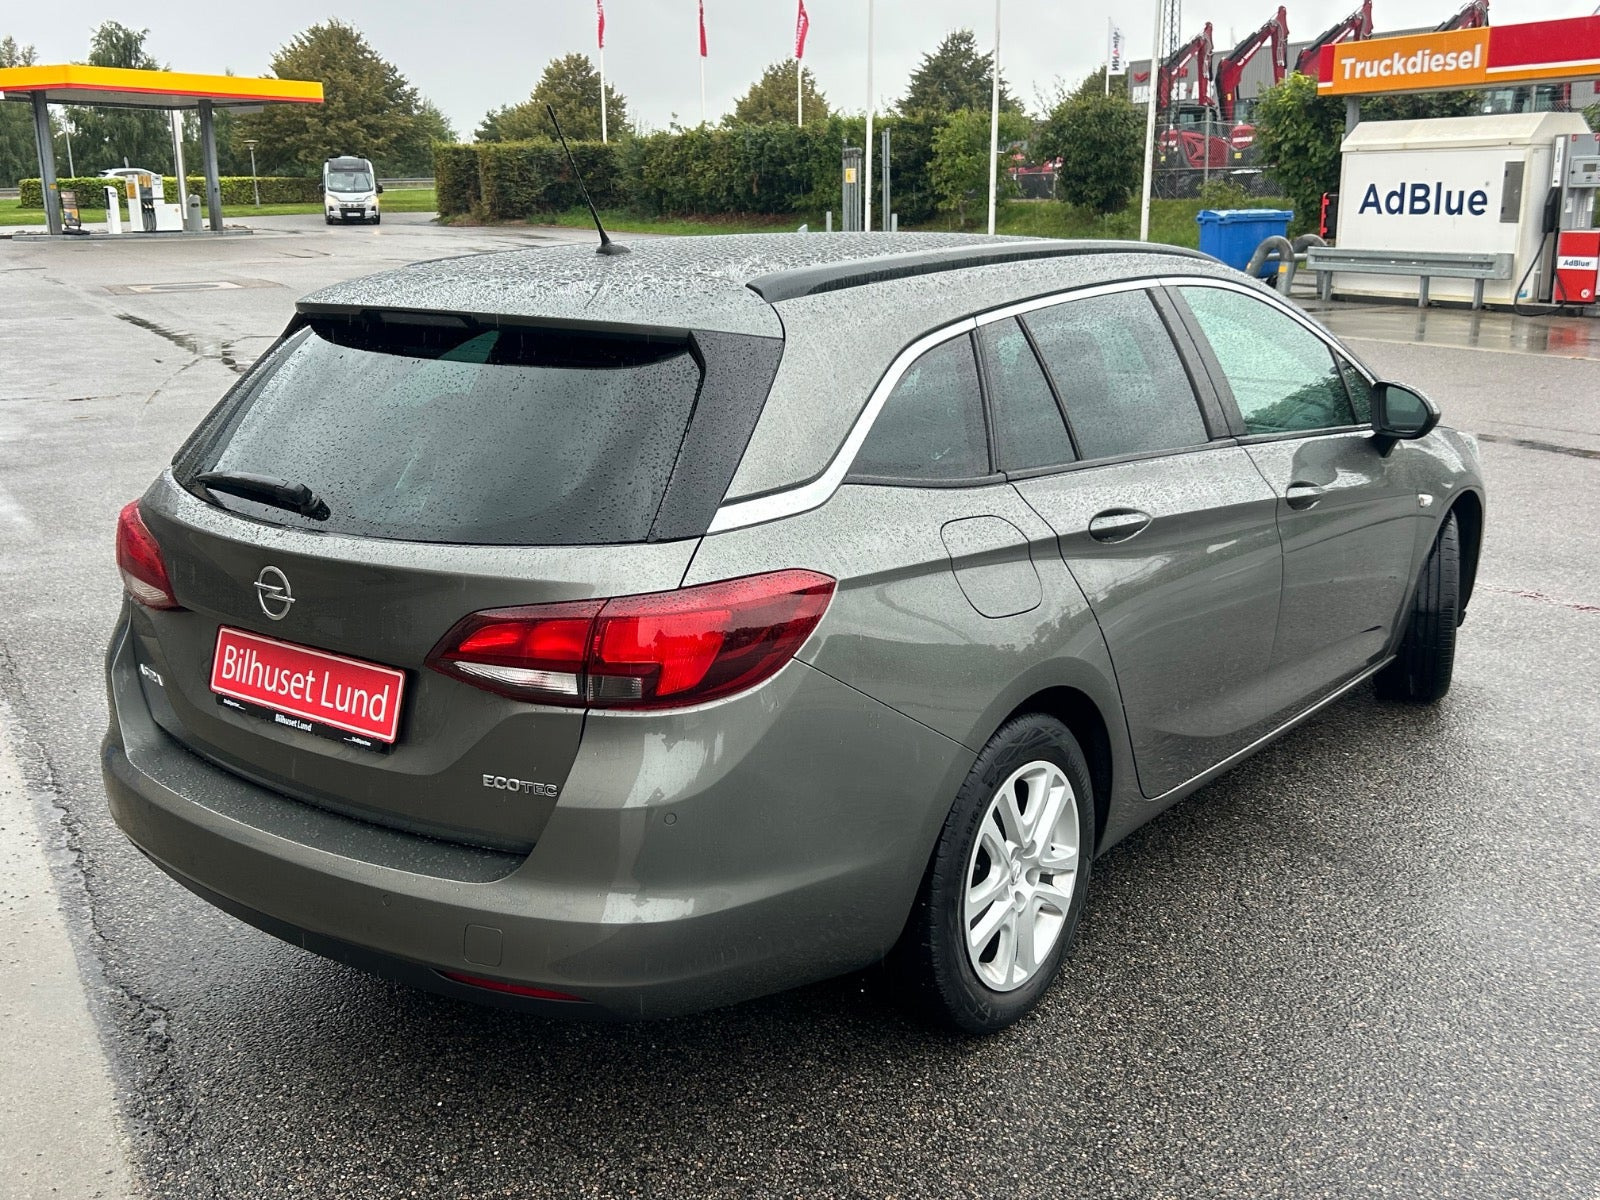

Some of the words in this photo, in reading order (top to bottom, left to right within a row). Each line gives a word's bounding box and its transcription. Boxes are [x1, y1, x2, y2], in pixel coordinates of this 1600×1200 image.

[1341, 43, 1482, 80] Truckdiesel
[1358, 182, 1488, 216] AdBlue
[221, 644, 316, 703] Bilhuset
[320, 671, 389, 723] Lund
[275, 713, 297, 728] Bilhuset
[297, 718, 312, 732] Lund
[482, 774, 558, 797] ECOTEC
